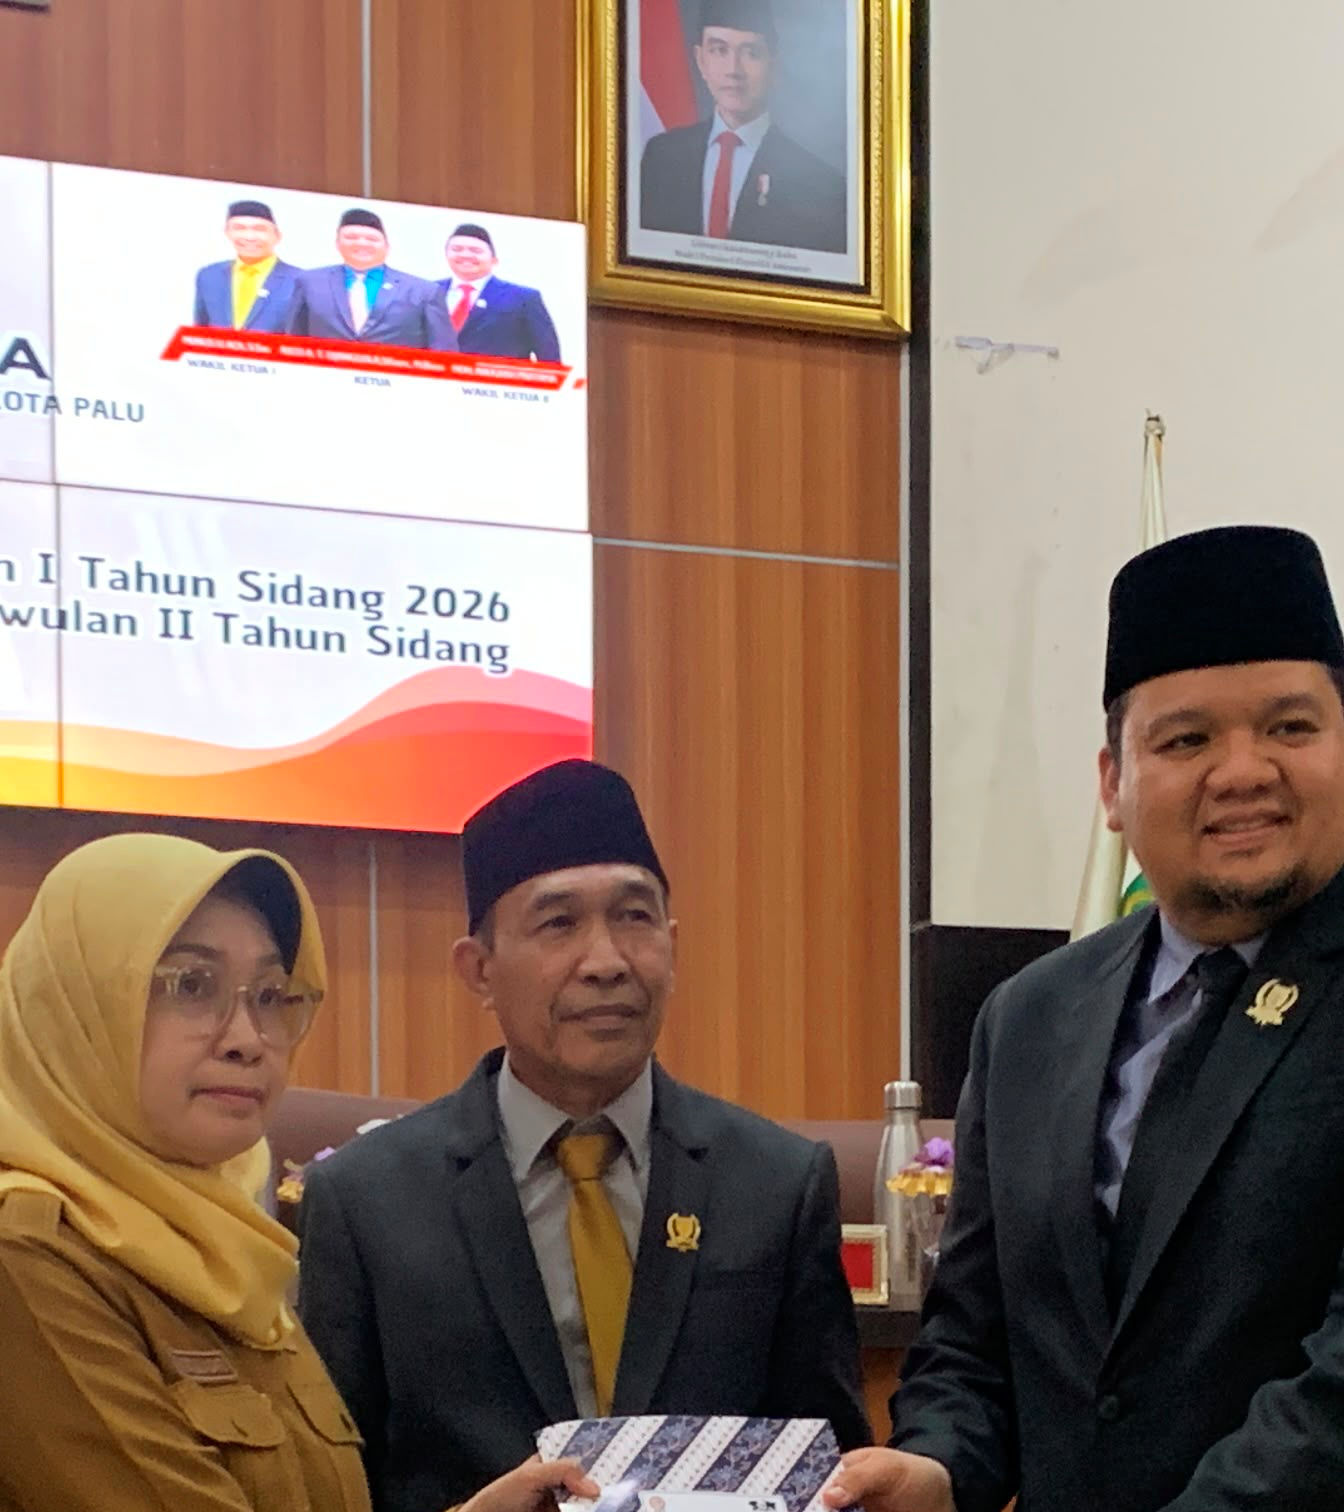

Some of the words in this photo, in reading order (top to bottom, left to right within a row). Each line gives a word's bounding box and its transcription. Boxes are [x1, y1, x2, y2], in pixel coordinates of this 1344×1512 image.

[74, 398, 145, 424] PALU
[39, 552, 57, 584] I
[79, 556, 216, 599] Tahun
[238, 570, 385, 622] Sidang
[406, 585, 510, 623] 2026
[159, 608, 194, 641] II
[213, 612, 347, 654] Tahun
[367, 625, 510, 674] Sidang
